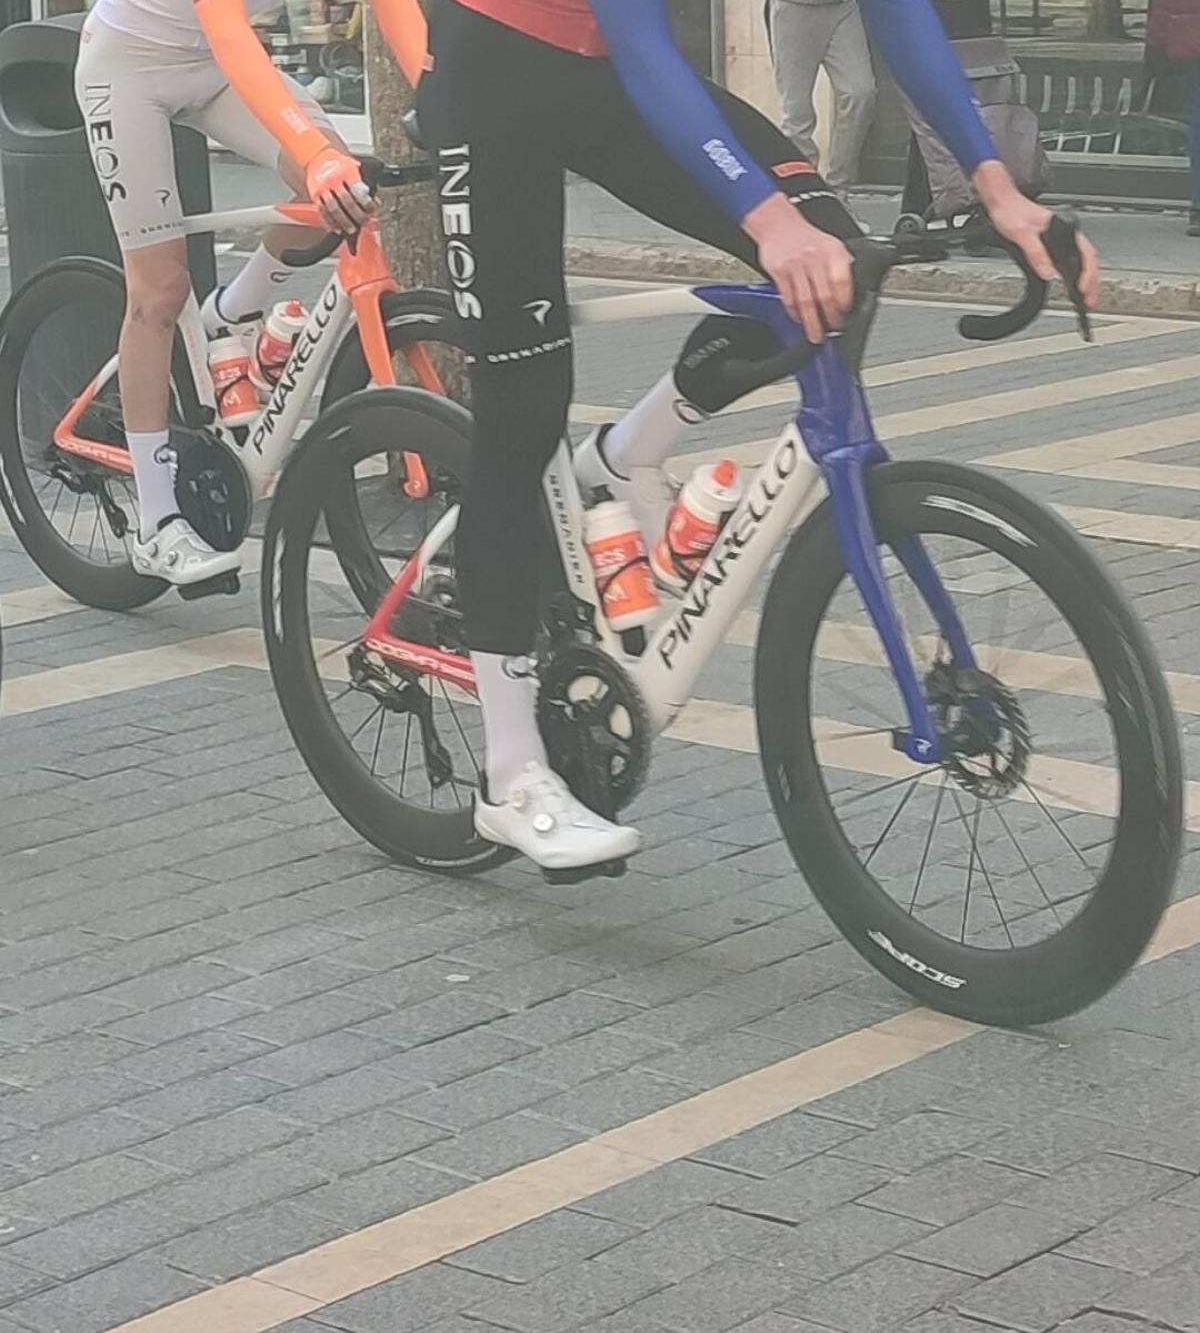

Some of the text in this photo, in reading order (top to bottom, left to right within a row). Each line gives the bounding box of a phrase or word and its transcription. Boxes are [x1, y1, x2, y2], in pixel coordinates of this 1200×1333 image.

[84, 82, 127, 202] INEOS
[438, 143, 483, 320] INEOS
[251, 282, 338, 456] PINARELLO
[657, 439, 798, 671] PINARELLO
[865, 929, 968, 989] SCOPE
